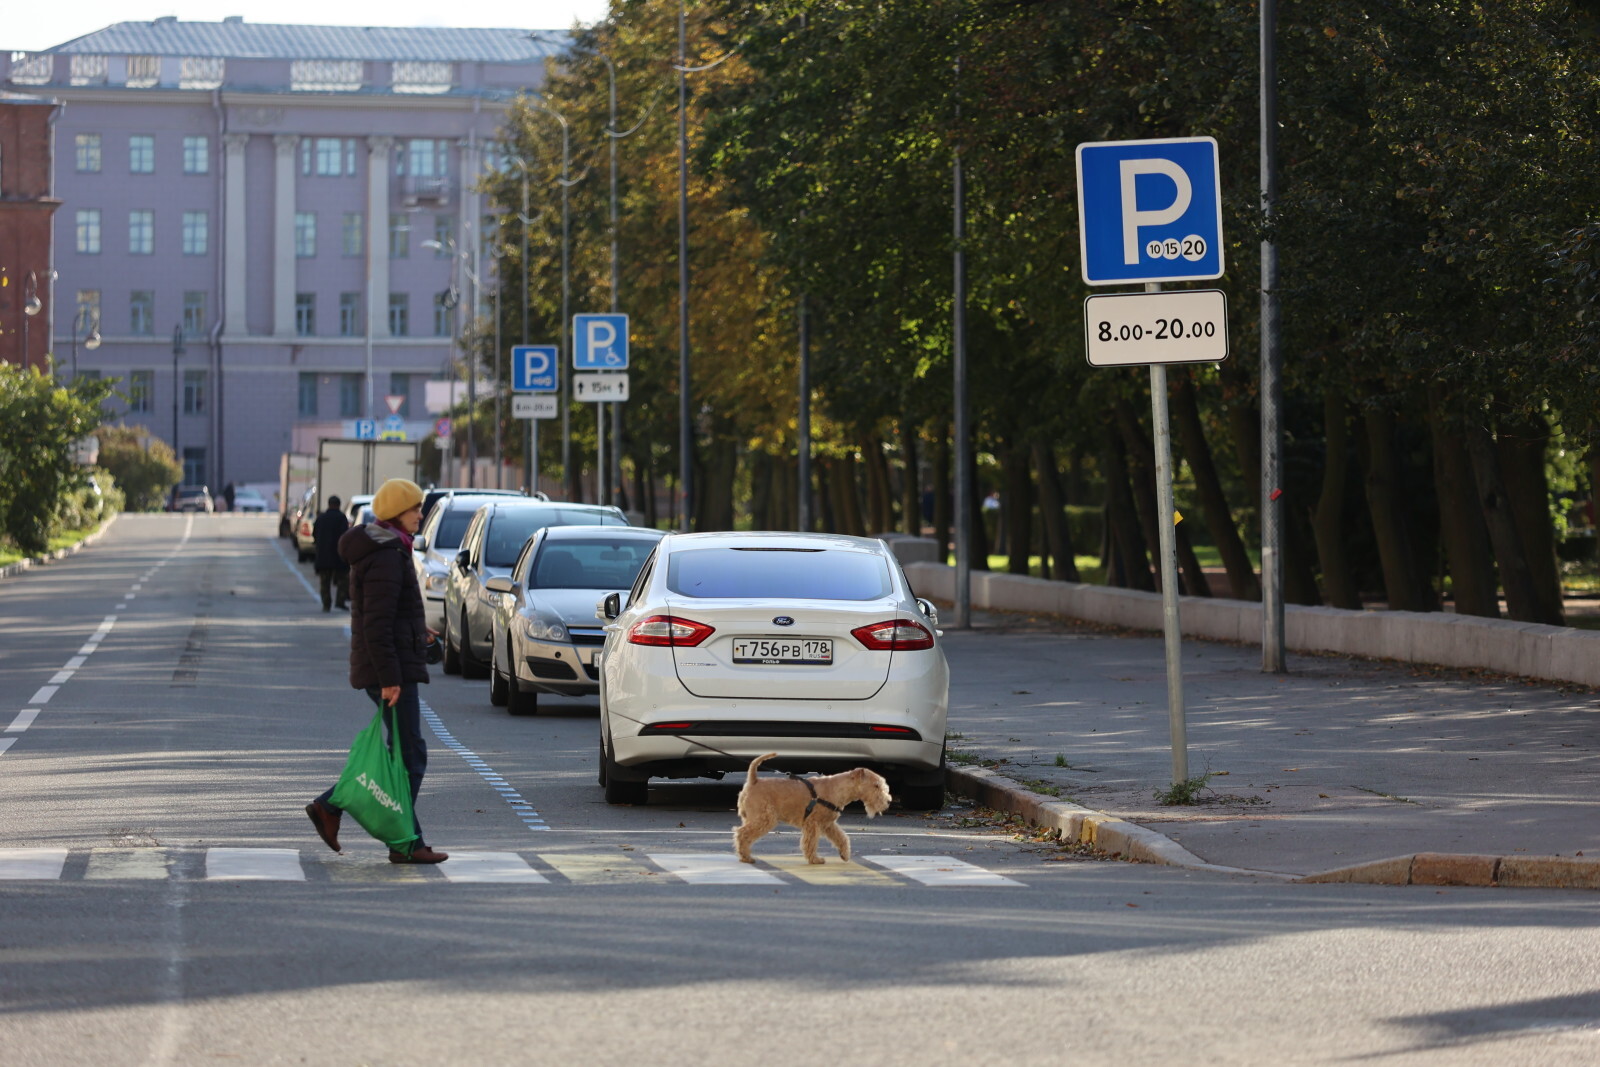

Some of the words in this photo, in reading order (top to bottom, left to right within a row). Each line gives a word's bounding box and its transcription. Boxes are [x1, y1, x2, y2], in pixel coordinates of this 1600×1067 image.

[1119, 158, 1192, 265] P
[1149, 244, 1161, 255] 10
[1165, 243, 1178, 255] 15
[1183, 240, 1205, 256] 20
[587, 321, 617, 363] P
[1098, 318, 1215, 342] 8.00-20.00
[525, 351, 550, 387] P
[804, 641, 828, 654] 178
[367, 779, 403, 814] PRISMA
